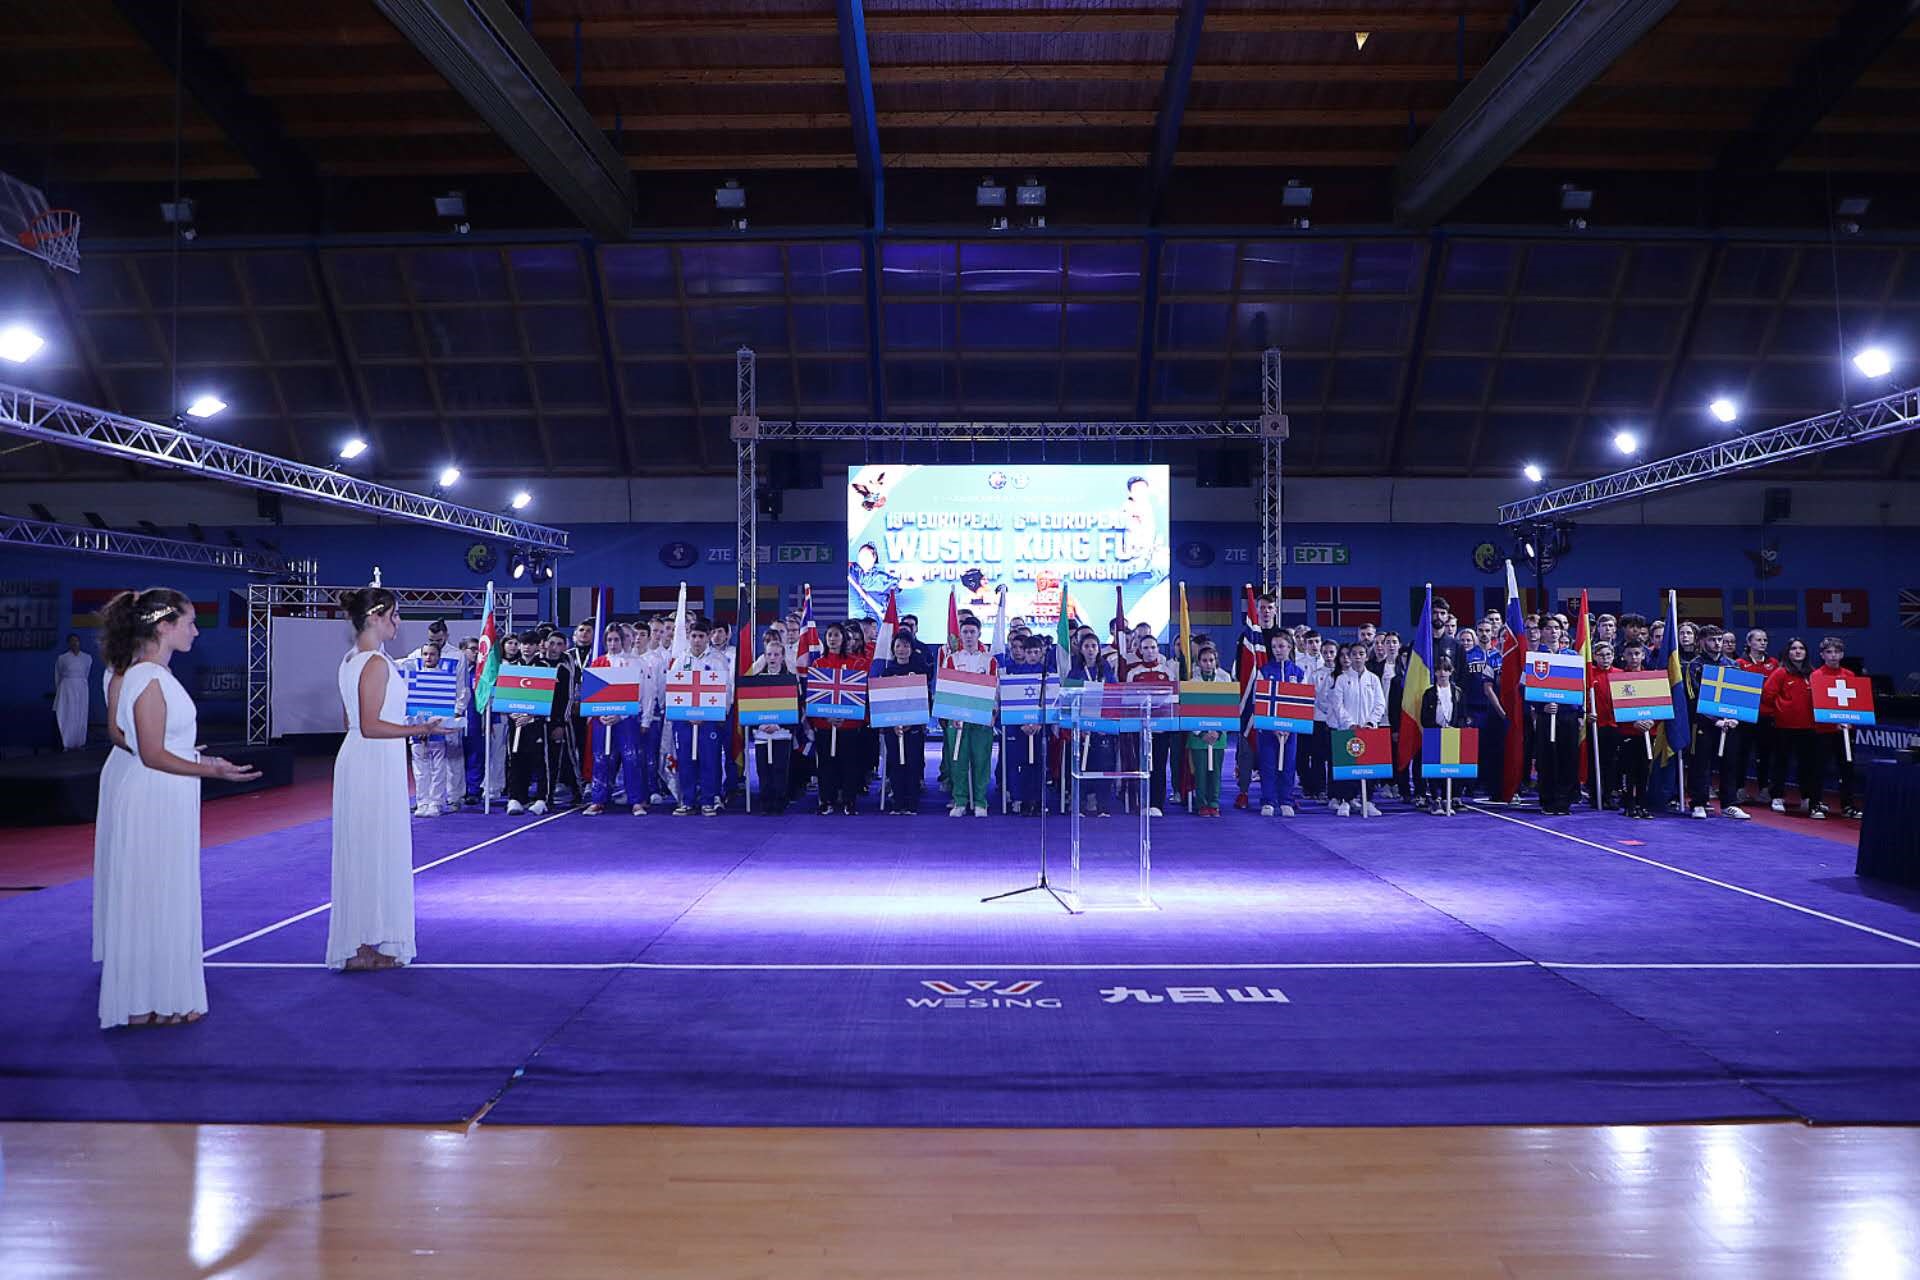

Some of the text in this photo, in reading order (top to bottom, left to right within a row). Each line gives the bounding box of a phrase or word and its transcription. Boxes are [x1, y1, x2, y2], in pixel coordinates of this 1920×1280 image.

[708, 548, 731, 561] ZTE
[885, 533, 1002, 563] WUSHU
[1015, 533, 1090, 562] KUNG
[1224, 548, 1247, 561] ZTE
[1855, 729, 1914, 749] ΛΛΗΝΙΚ
[907, 997, 1063, 1009] WESING
